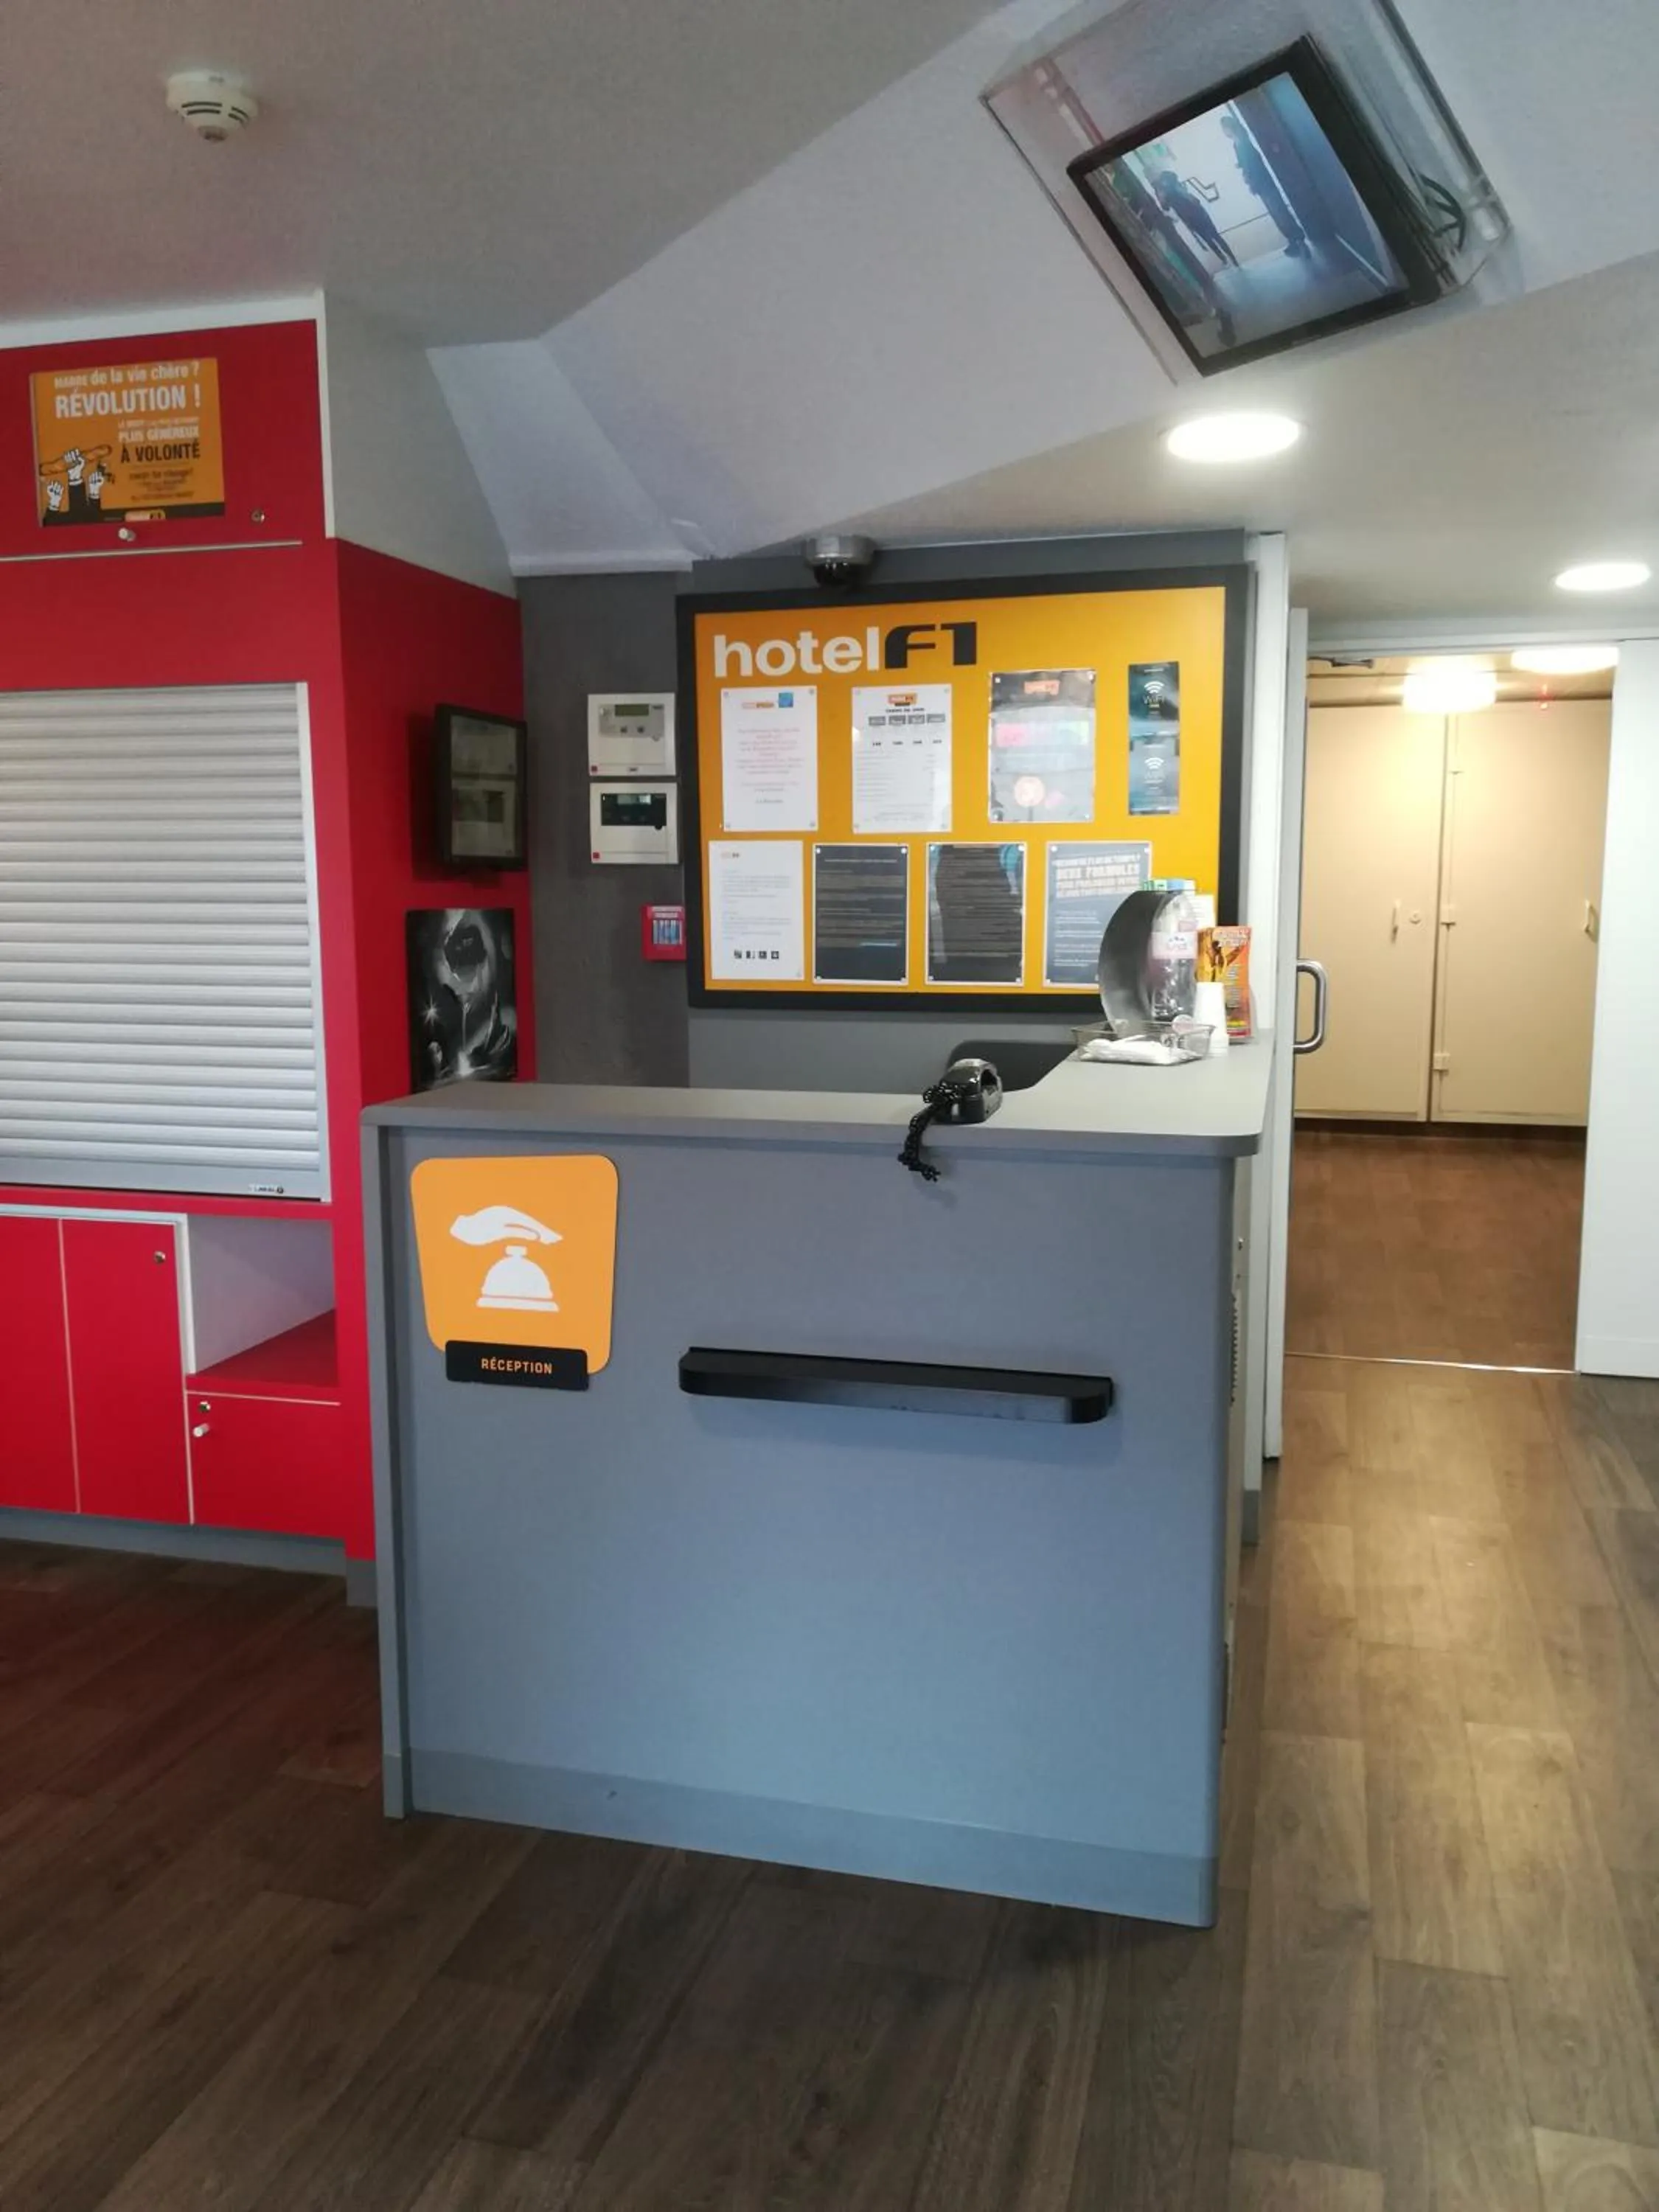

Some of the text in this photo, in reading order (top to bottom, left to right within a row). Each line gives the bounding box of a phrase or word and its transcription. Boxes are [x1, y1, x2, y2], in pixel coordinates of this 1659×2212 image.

[55, 384, 186, 419] RÉVOLUTION
[136, 439, 201, 462] VOLONTÉ
[481, 1356, 553, 1374] RÉCEPTION
